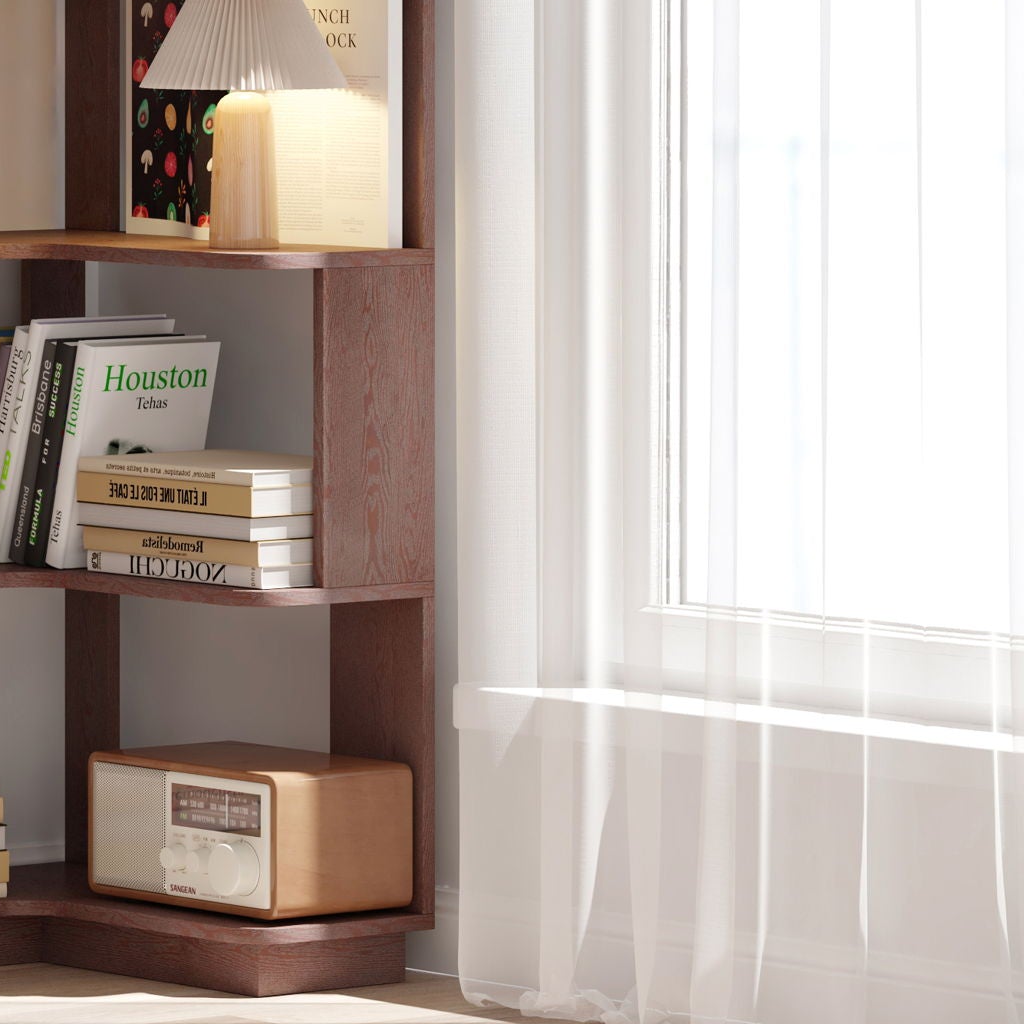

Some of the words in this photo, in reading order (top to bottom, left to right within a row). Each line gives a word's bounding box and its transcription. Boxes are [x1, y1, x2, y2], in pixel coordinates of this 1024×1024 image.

[10, 350, 32, 433] TALKS
[103, 363, 208, 392] Houston
[135, 395, 168, 411] Tehas
[13, 485, 30, 547] Queensland
[32, 359, 51, 435] Brisbane
[29, 488, 43, 546] FORMULA
[42, 437, 51, 465] FOR
[48, 362, 62, 418] SUCCESS
[50, 509, 63, 544] Tehas
[65, 366, 86, 437] Houston
[170, 884, 196, 895] SANGEAN
